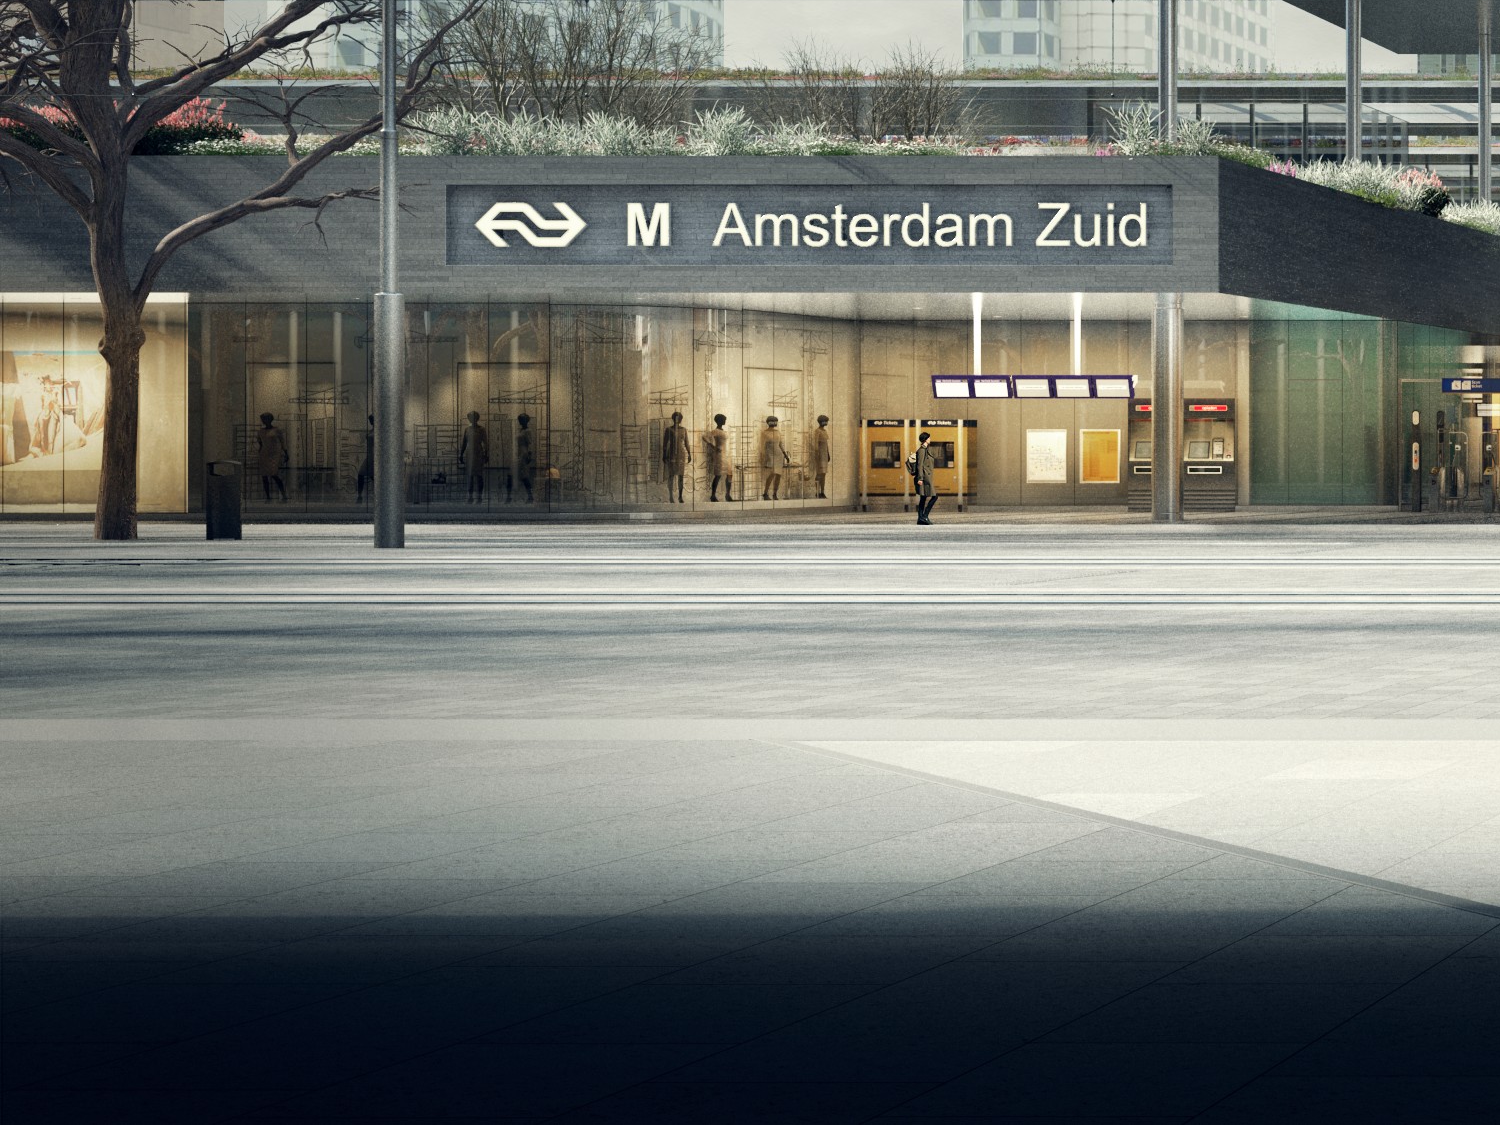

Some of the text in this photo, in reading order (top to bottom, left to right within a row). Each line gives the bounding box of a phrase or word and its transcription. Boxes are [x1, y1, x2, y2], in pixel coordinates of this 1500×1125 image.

[626, 202, 1148, 247] M Amsterdam Zuid
